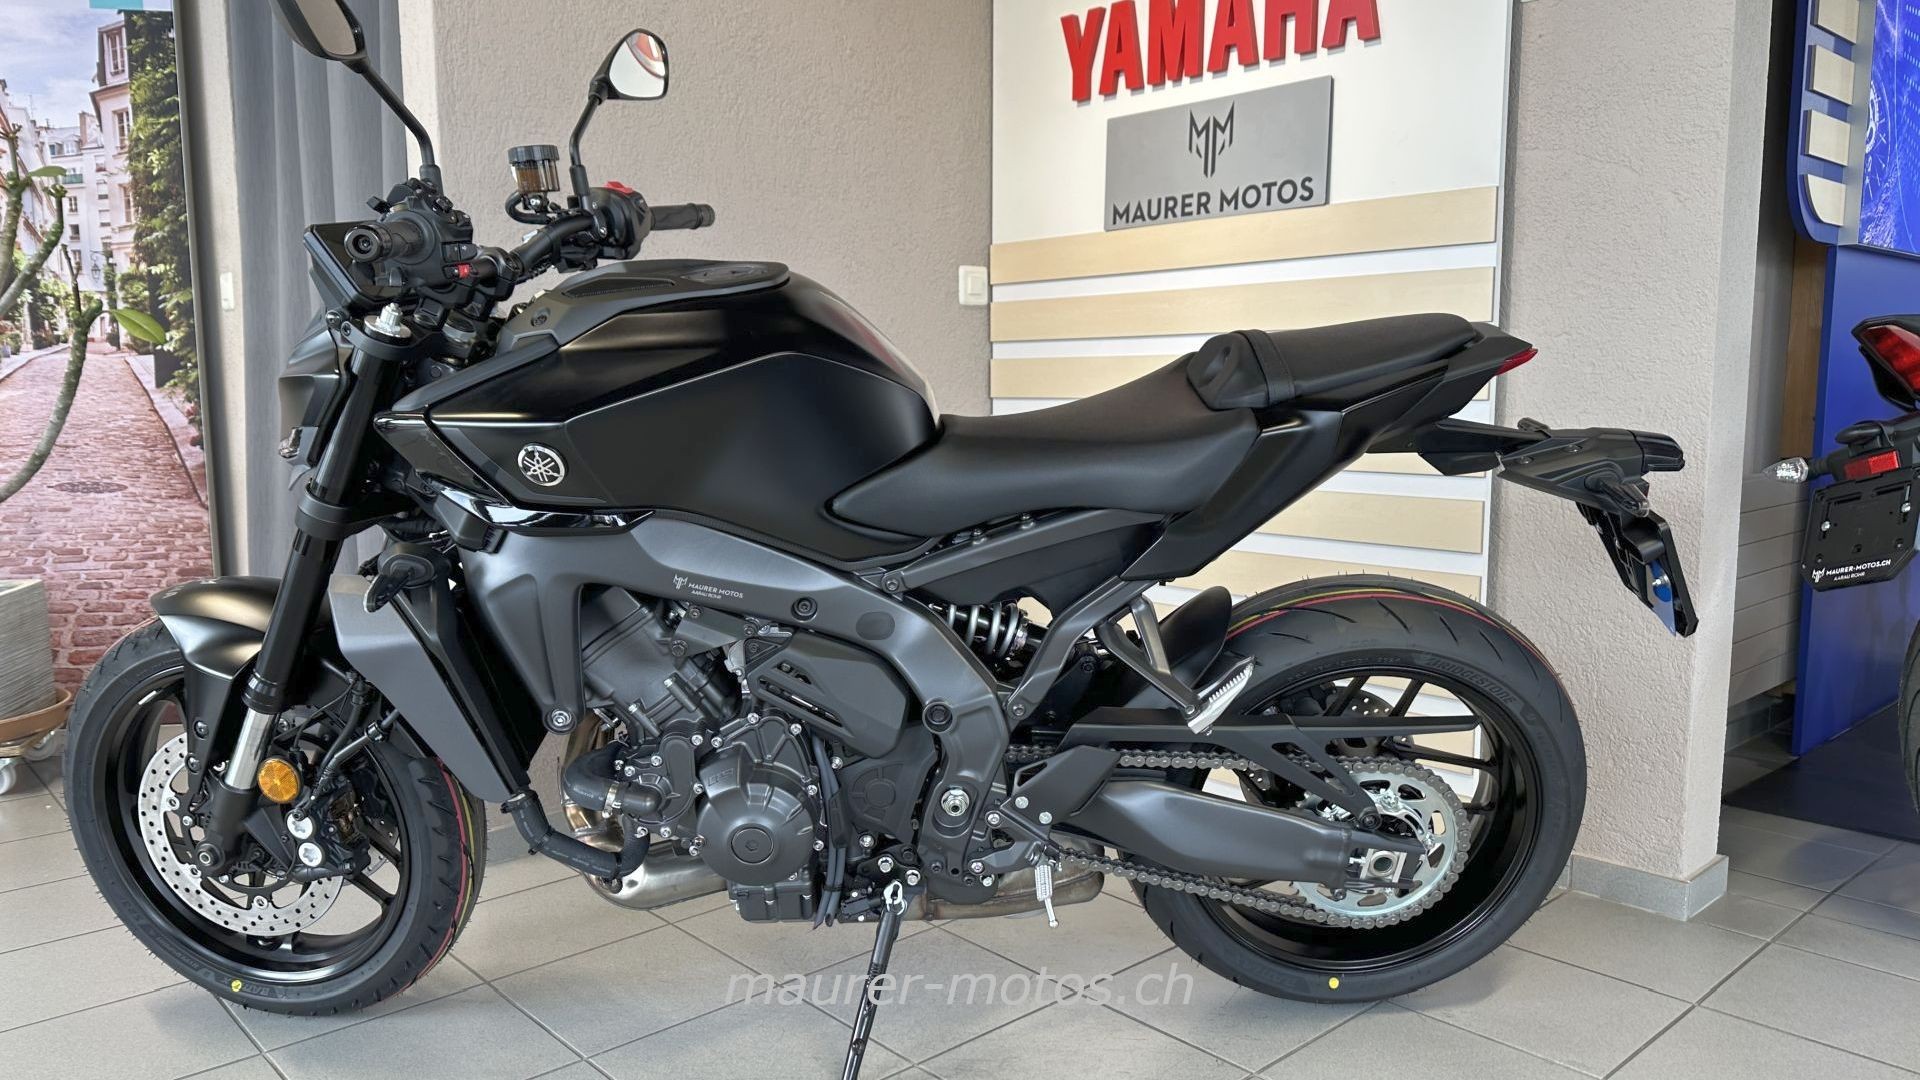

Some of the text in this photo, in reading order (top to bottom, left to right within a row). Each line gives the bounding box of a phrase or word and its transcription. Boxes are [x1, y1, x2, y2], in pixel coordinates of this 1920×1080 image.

[1060, 0, 1381, 102] YAMAHA
[1112, 176, 1314, 226] MAURER MOTOS
[1825, 559, 1891, 575] MAURER-MOTOS.CH
[688, 583, 744, 599] MAURER MOTOS
